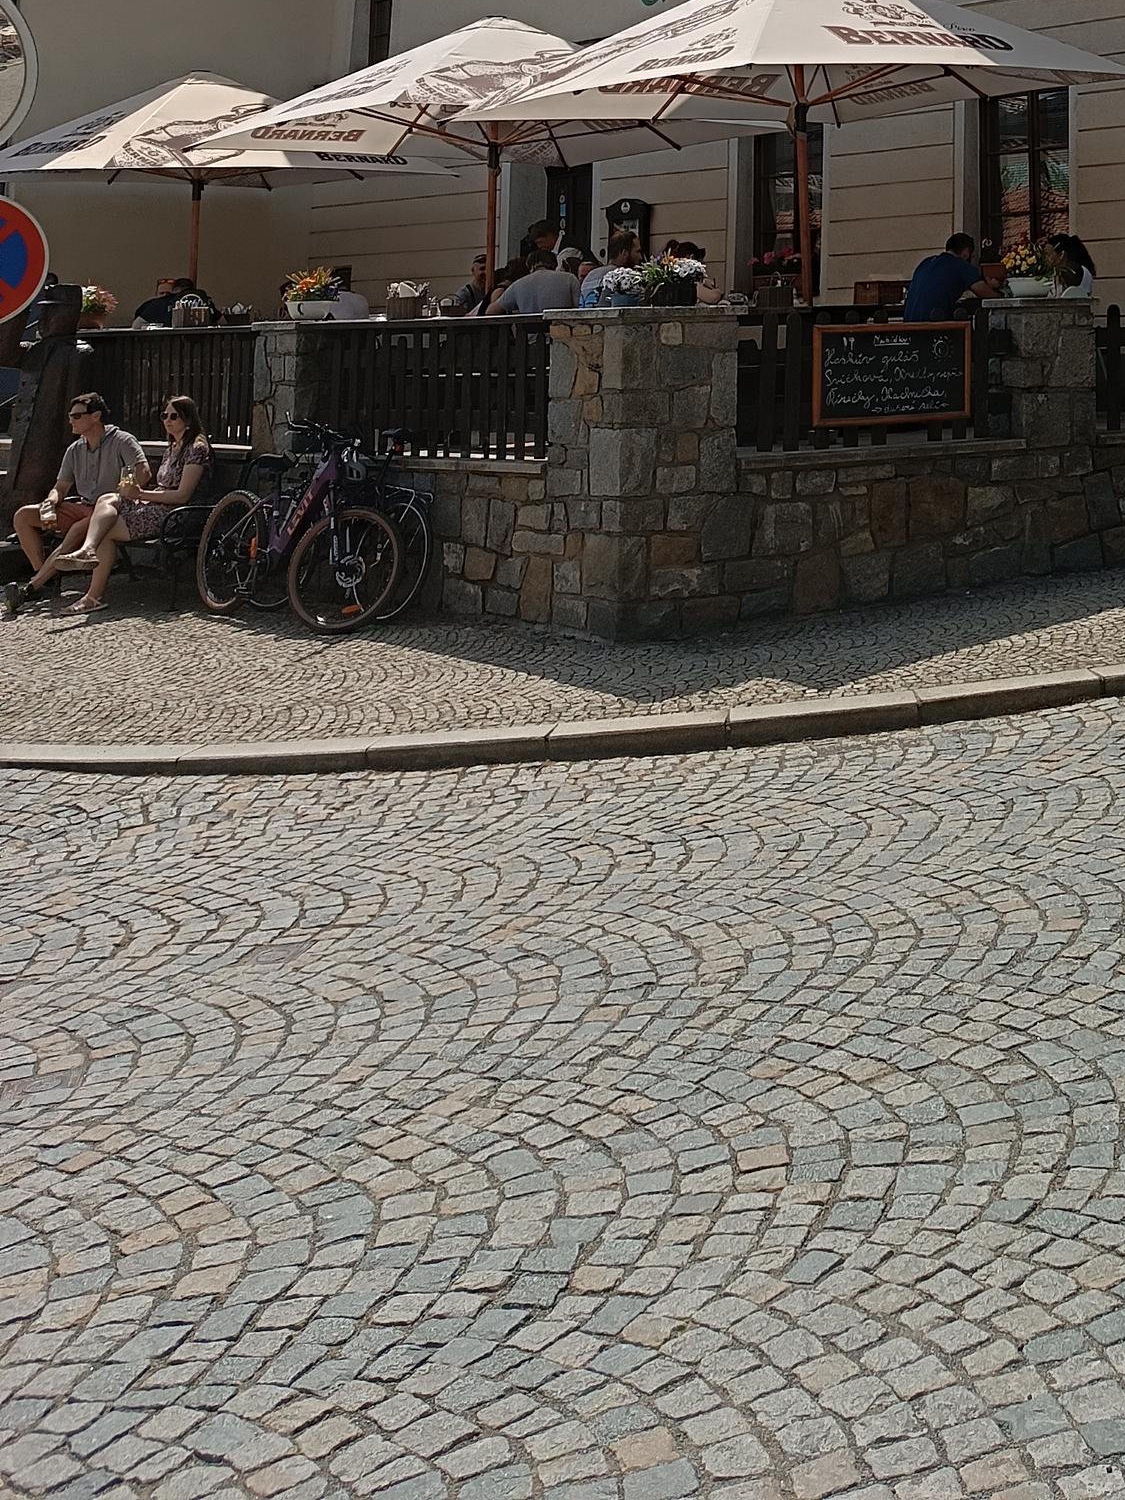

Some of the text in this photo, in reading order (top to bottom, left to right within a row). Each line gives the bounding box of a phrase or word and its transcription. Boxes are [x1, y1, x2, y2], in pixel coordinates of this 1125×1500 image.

[821, 25, 1014, 51] BERNARD
[628, 45, 736, 73] BERNARD
[313, 152, 408, 166] BERNARD
